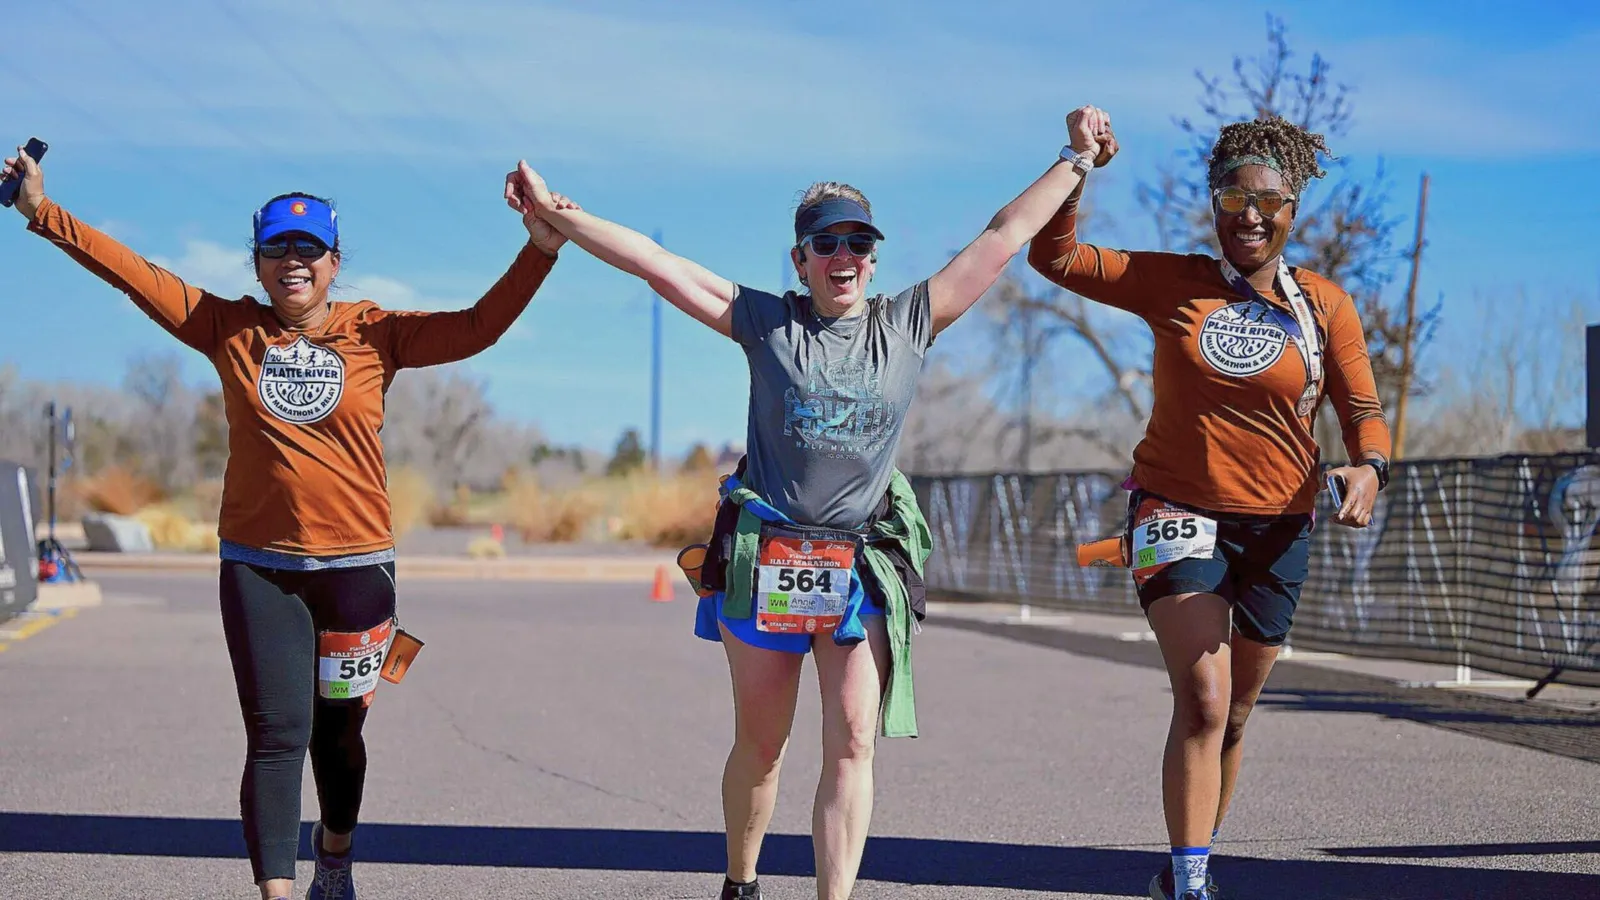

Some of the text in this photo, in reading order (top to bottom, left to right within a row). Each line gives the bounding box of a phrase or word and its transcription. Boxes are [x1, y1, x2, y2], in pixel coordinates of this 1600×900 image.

[1207, 321, 1282, 340] PLATTE RIVER
[1206, 334, 1214, 352] HALF
[1212, 350, 1252, 369] MARATHON
[1260, 345, 1277, 363] RELAY
[270, 354, 281, 362] 20
[265, 367, 338, 379] PLATTE RIVER
[265, 383, 276, 399] HALF
[272, 398, 314, 417] MARATHON
[320, 386, 336, 408] RELAY
[795, 441, 823, 450] HALF
[1146, 518, 1197, 545] 565
[793, 559, 841, 567] MARATHON
[1140, 552, 1154, 563] WL
[777, 568, 832, 593] 564
[770, 597, 816, 607] WM Annie
[339, 650, 383, 680] 563
[331, 685, 349, 694] WM
